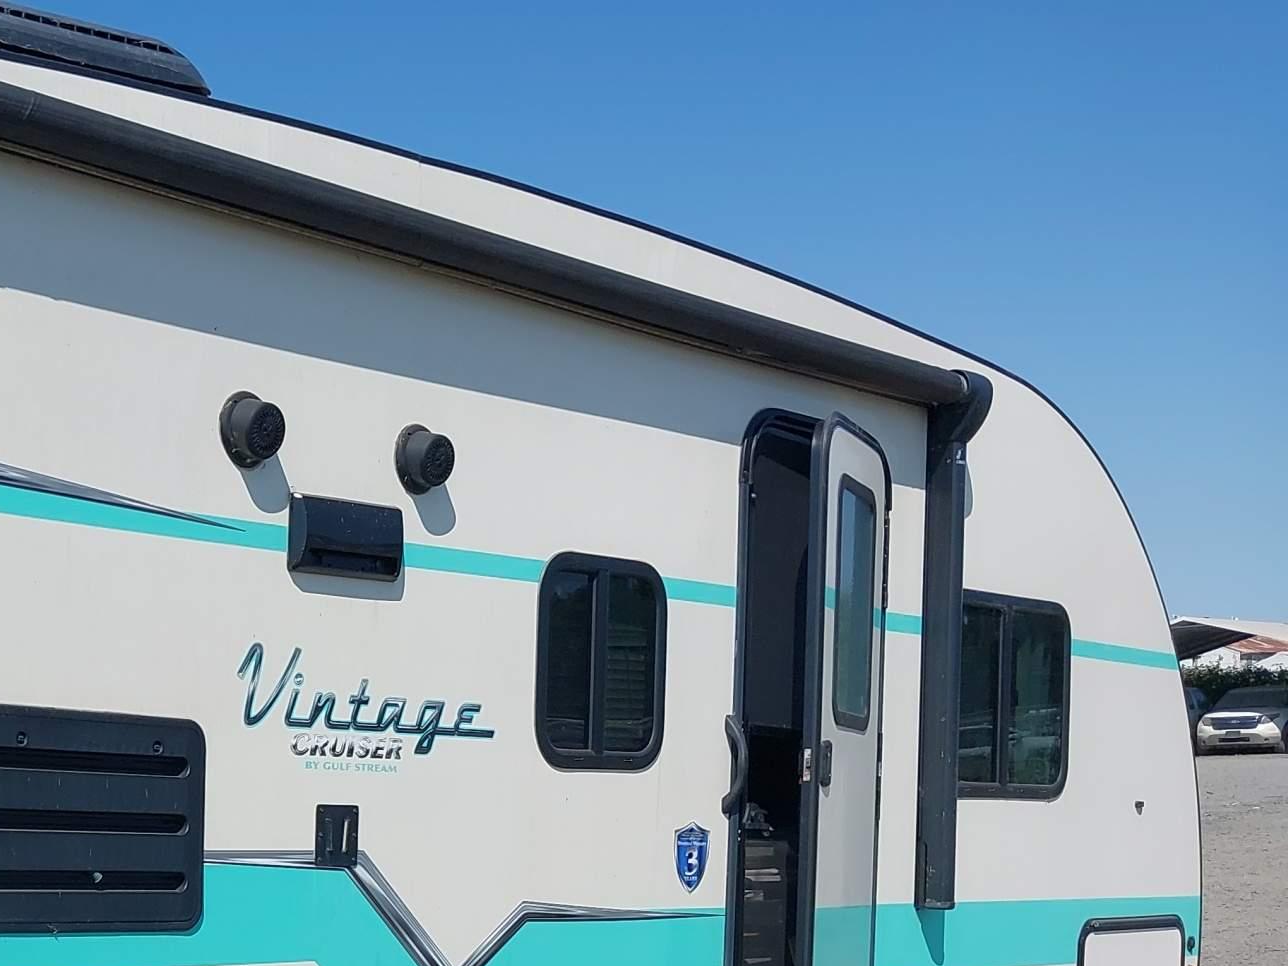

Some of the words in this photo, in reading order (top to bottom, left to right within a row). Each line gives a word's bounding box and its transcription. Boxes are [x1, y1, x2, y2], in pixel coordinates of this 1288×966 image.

[236, 641, 496, 755] Vintage
[289, 732, 404, 760] CRUISER
[304, 760, 320, 770] BY
[323, 761, 353, 772] GULF
[354, 762, 398, 773] STREAM
[684, 846, 700, 876] 3
